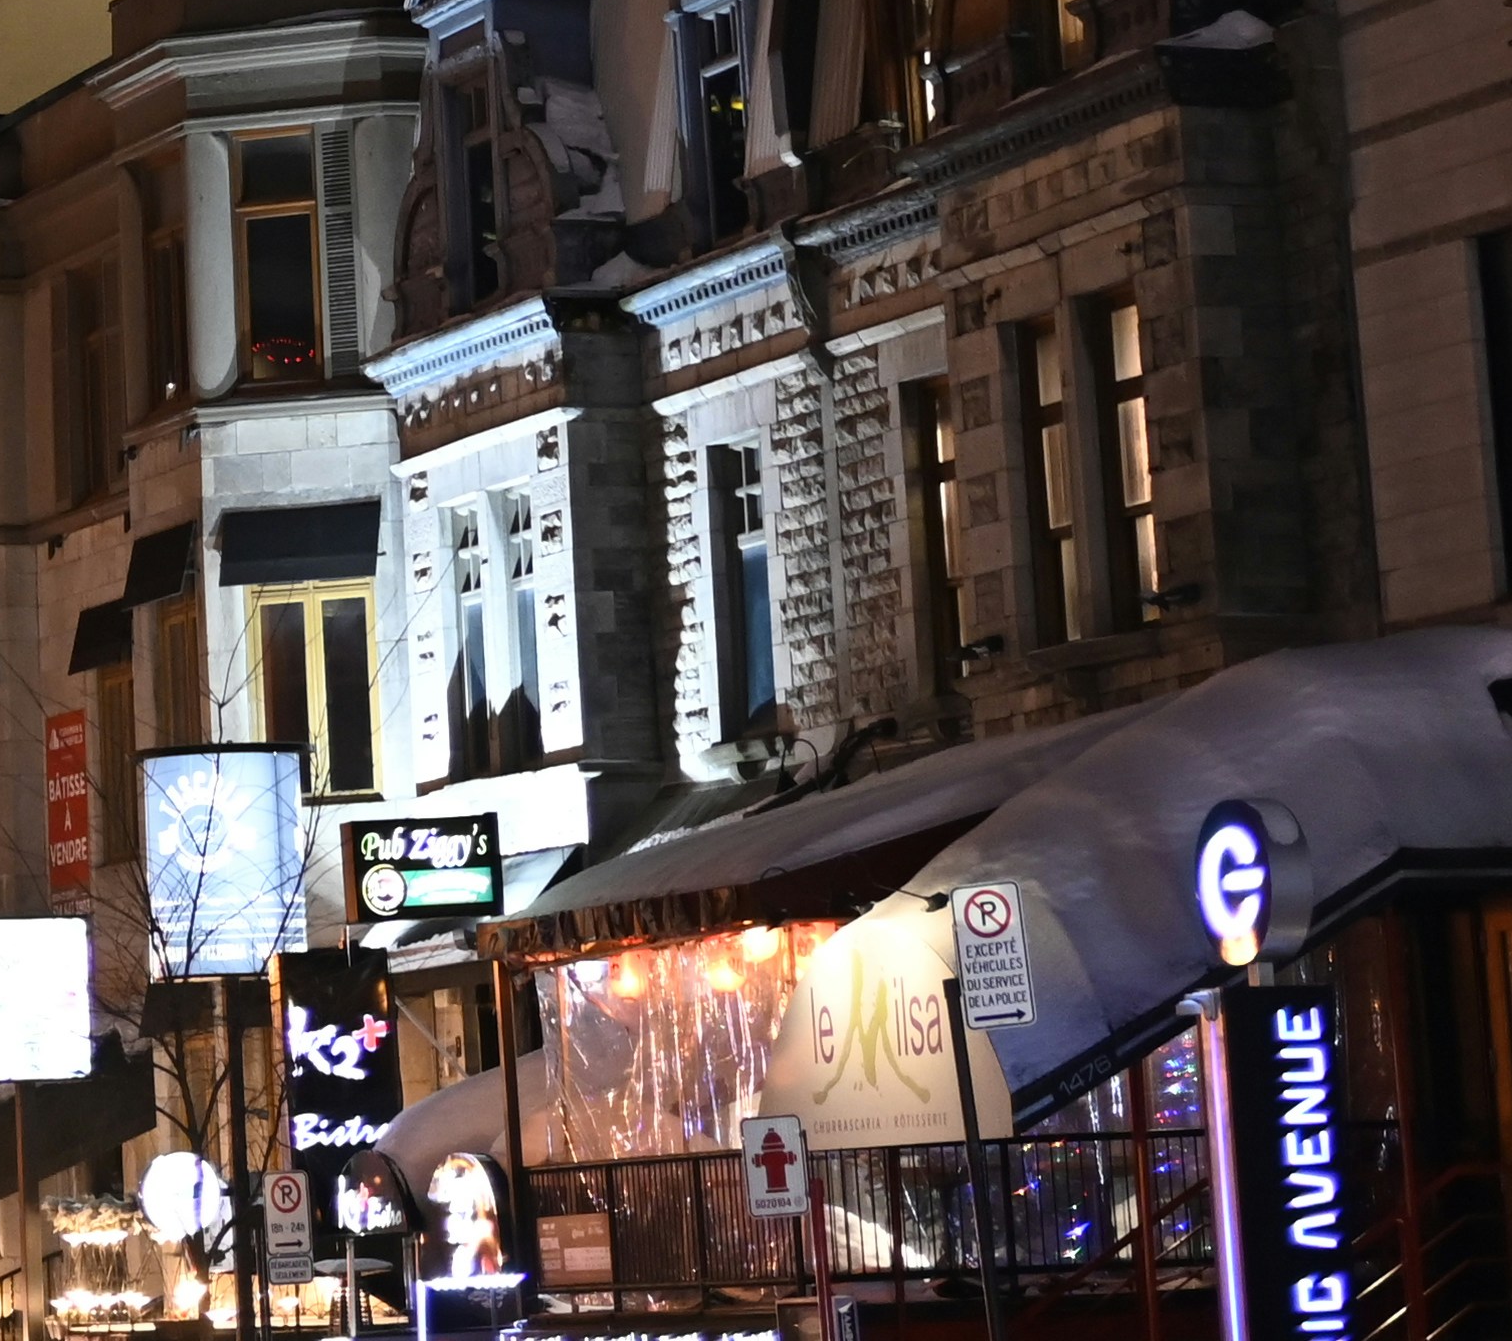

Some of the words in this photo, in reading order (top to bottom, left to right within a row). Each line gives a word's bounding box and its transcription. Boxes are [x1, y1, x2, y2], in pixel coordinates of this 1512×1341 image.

[50, 837, 87, 867] VENDRE
[361, 826, 405, 860] Pub
[407, 823, 488, 868] Ziggy's
[966, 937, 1017, 958] EXCEPTÉ
[965, 957, 1023, 975] VÉHICULES
[966, 979, 981, 992] DU
[983, 974, 1025, 990] SERVICE
[969, 996, 980, 1008] DE
[982, 994, 995, 1007] LA
[996, 990, 1028, 1006] POLICE
[811, 987, 834, 1064] le
[813, 1117, 881, 1135] CHURRASCARIA
[894, 1112, 948, 1129] RÔTISSERIE
[1277, 1006, 1340, 1250] AVENUE
